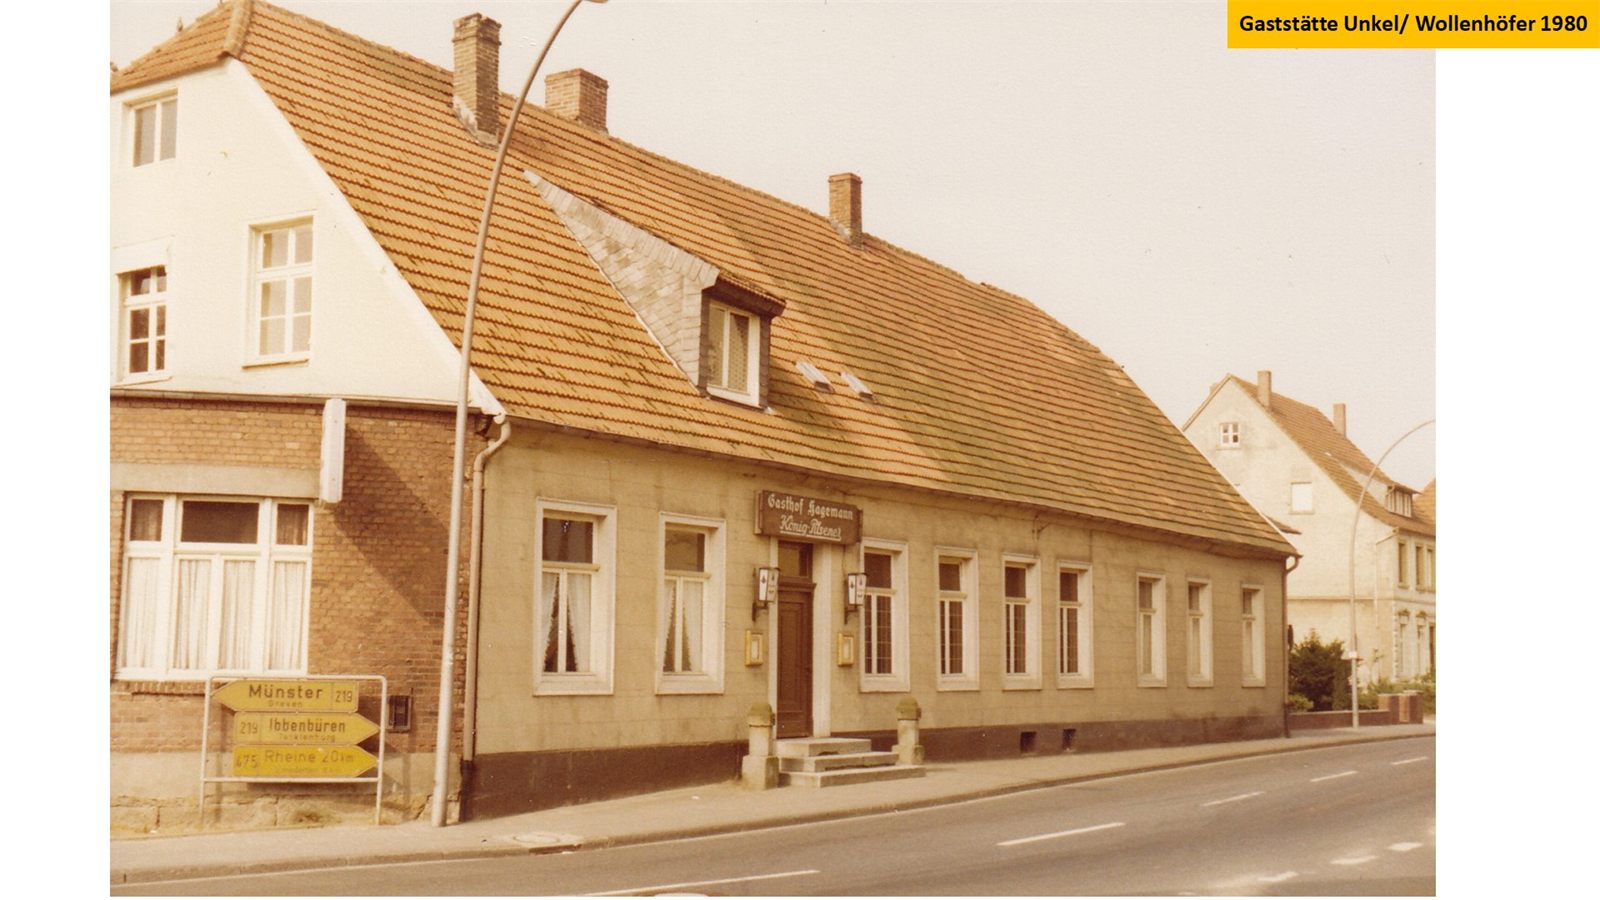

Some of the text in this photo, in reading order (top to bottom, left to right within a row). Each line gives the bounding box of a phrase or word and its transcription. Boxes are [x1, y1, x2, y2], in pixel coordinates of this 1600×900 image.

[768, 493, 853, 520] Gasthof Hagemann
[248, 684, 353, 703] Münster 219
[239, 718, 346, 735] 219 Ibbenbüren
[235, 754, 258, 769] 475
[264, 750, 316, 763] Rheine
